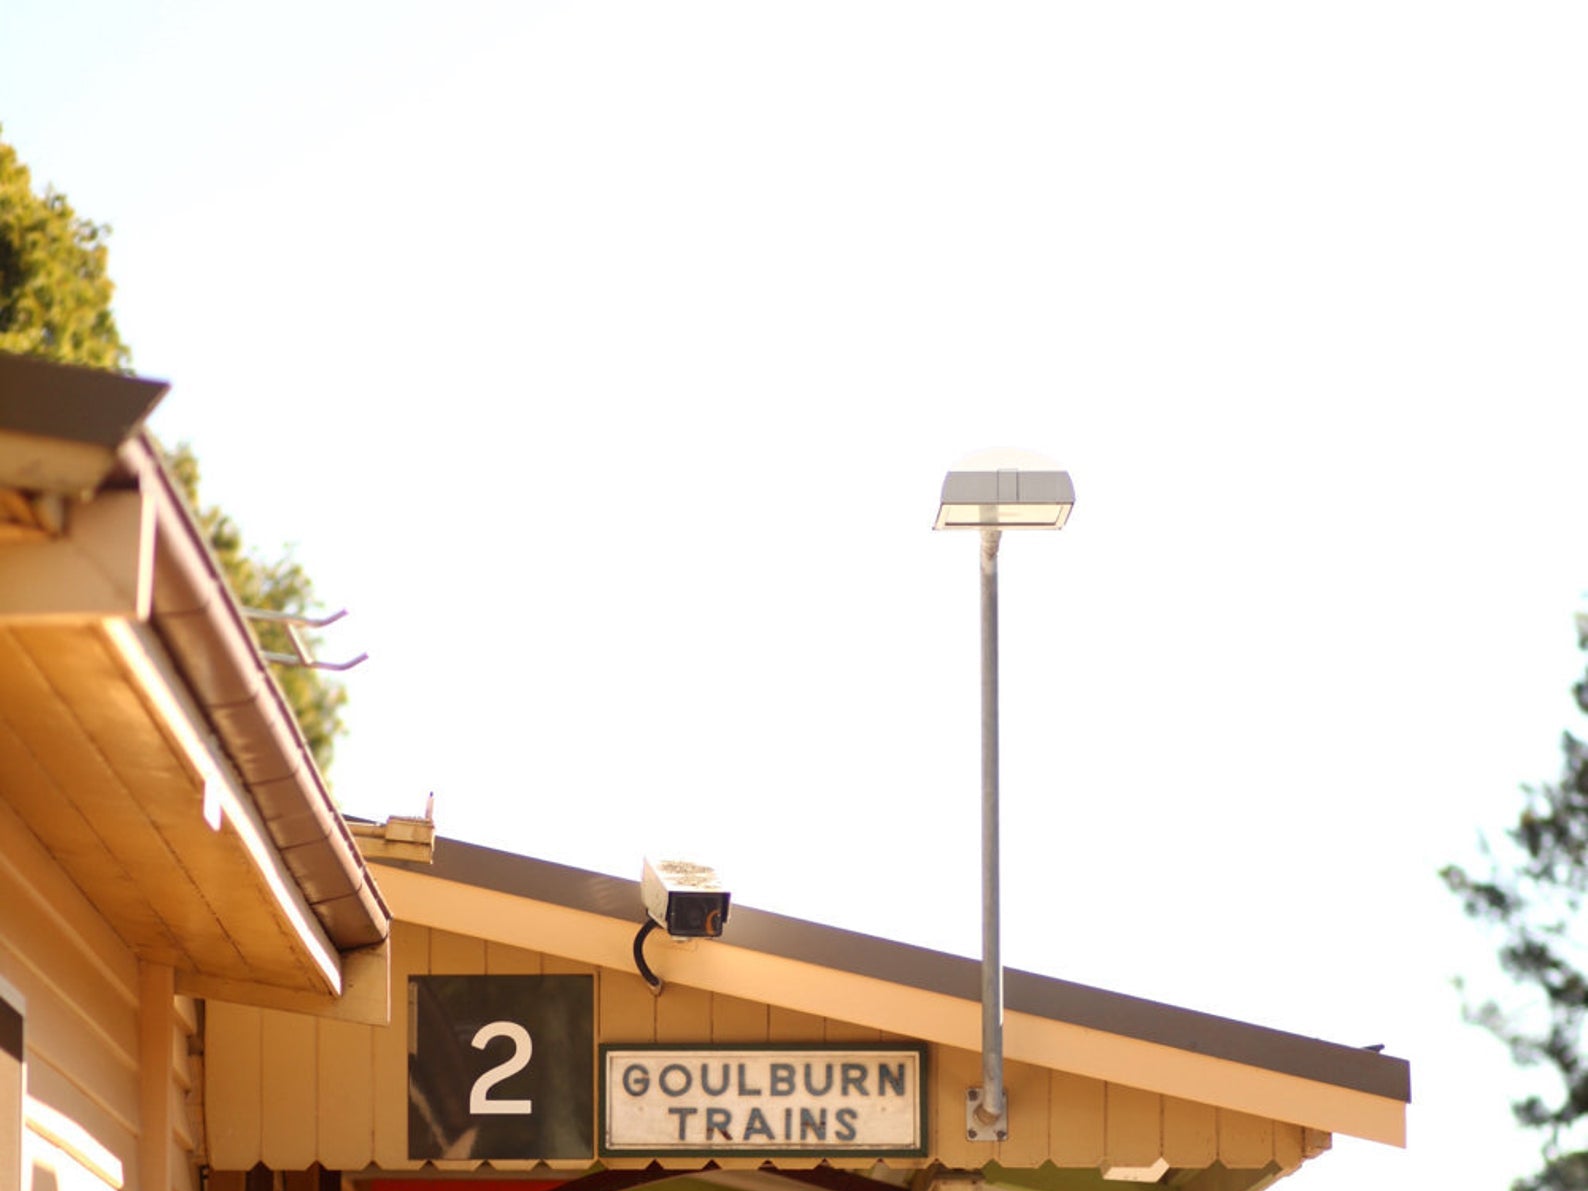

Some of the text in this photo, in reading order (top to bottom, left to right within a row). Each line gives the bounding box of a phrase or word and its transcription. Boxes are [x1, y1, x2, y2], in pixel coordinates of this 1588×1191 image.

[469, 1020, 533, 1115] 2
[622, 1063, 906, 1098] GOULBURN
[668, 1107, 859, 1142] TRAINS
